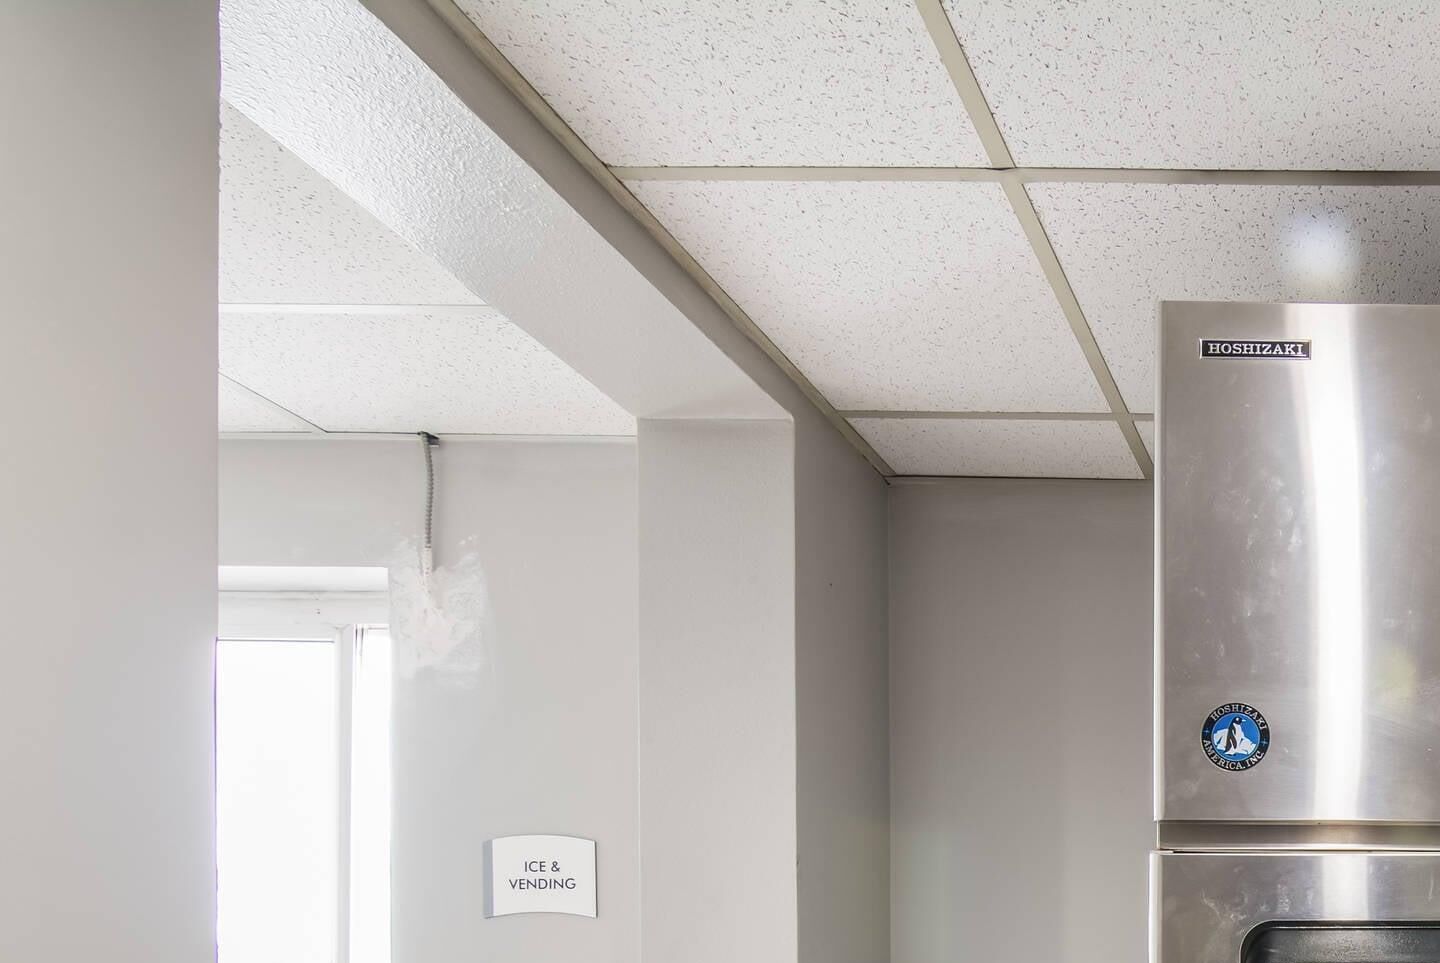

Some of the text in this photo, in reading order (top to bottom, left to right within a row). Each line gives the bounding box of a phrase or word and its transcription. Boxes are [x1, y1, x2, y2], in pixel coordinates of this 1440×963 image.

[1208, 343, 1306, 356] HOSHIZAKI
[1210, 704, 1267, 730] HOSHIZAKI
[524, 860, 561, 873] ICE &
[508, 878, 577, 890] VENDING
